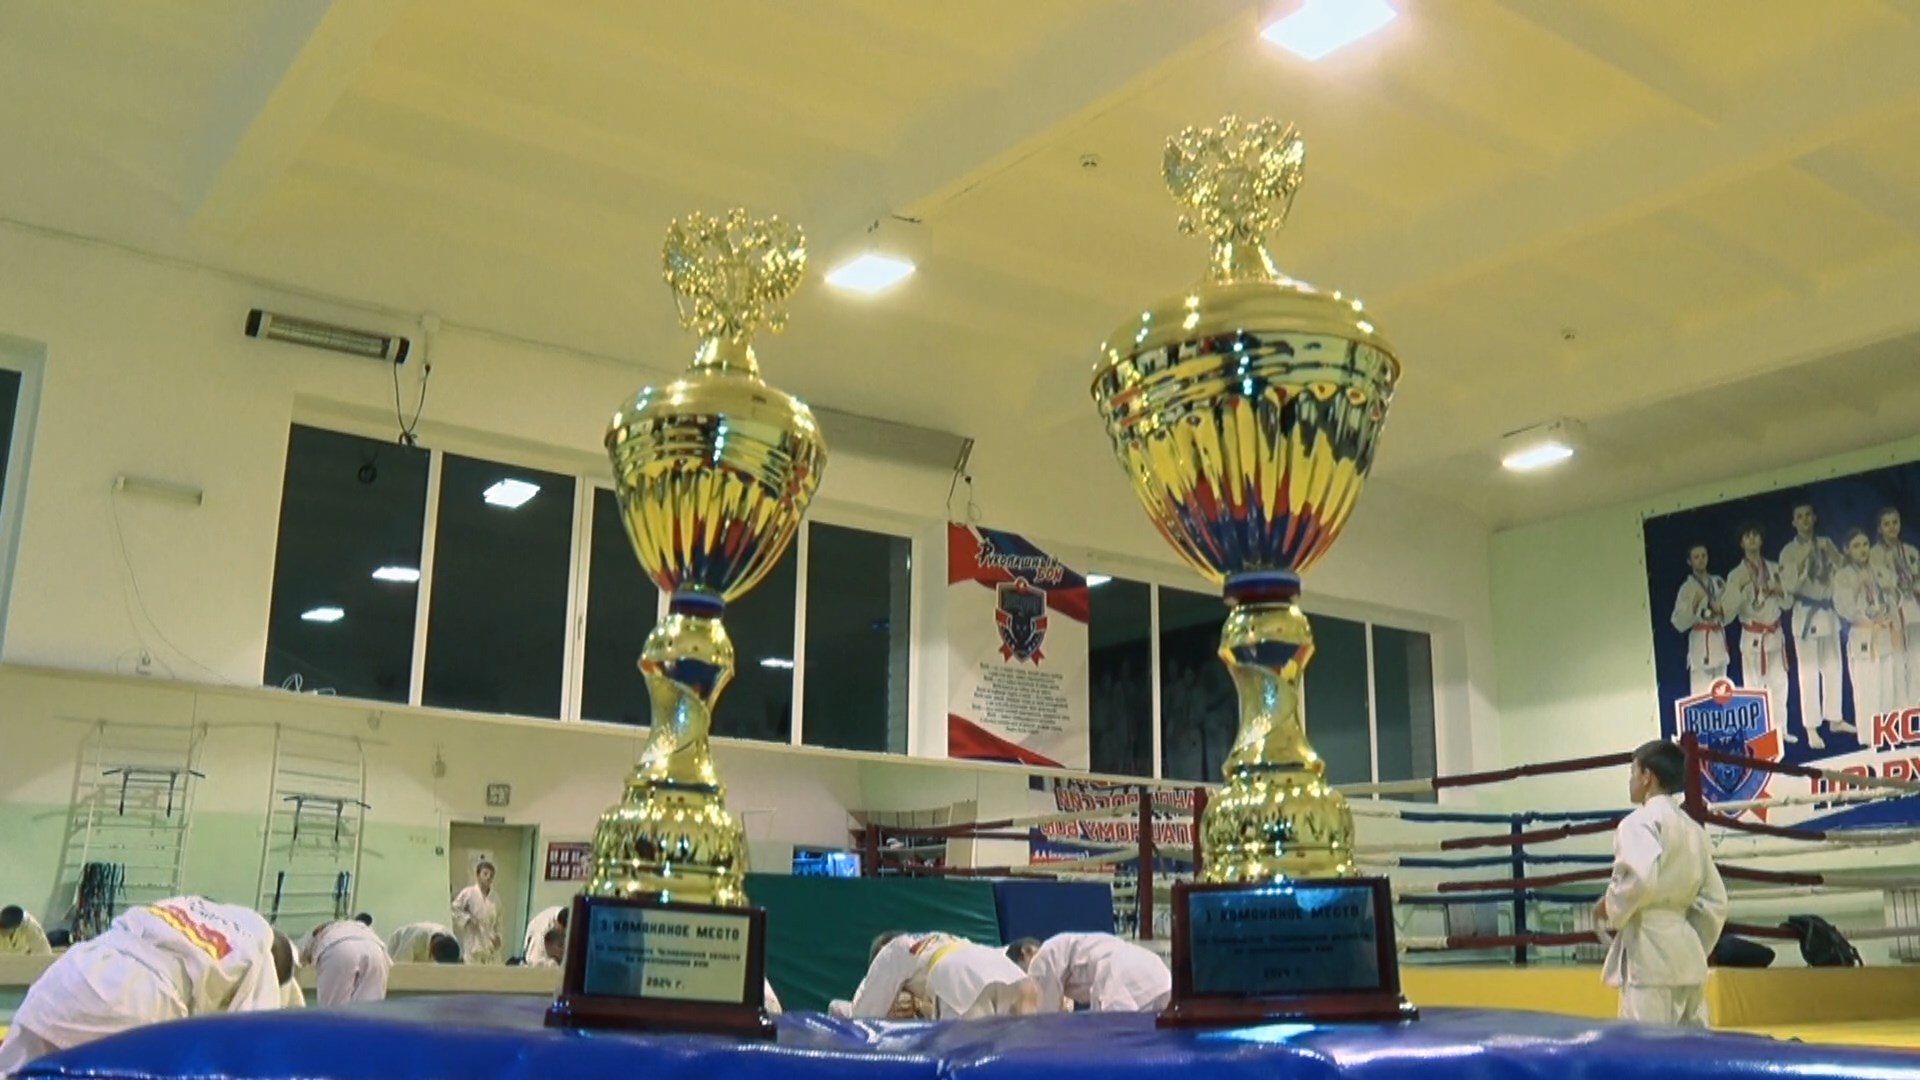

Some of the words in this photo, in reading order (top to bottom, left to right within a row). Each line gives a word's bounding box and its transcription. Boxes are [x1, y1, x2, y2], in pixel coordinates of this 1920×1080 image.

[1685, 701, 1761, 735] КОНДОР
[1311, 904, 1360, 920] МЕСТО
[696, 925, 740, 941] МЕСТО
[646, 976, 672, 988] 2024
